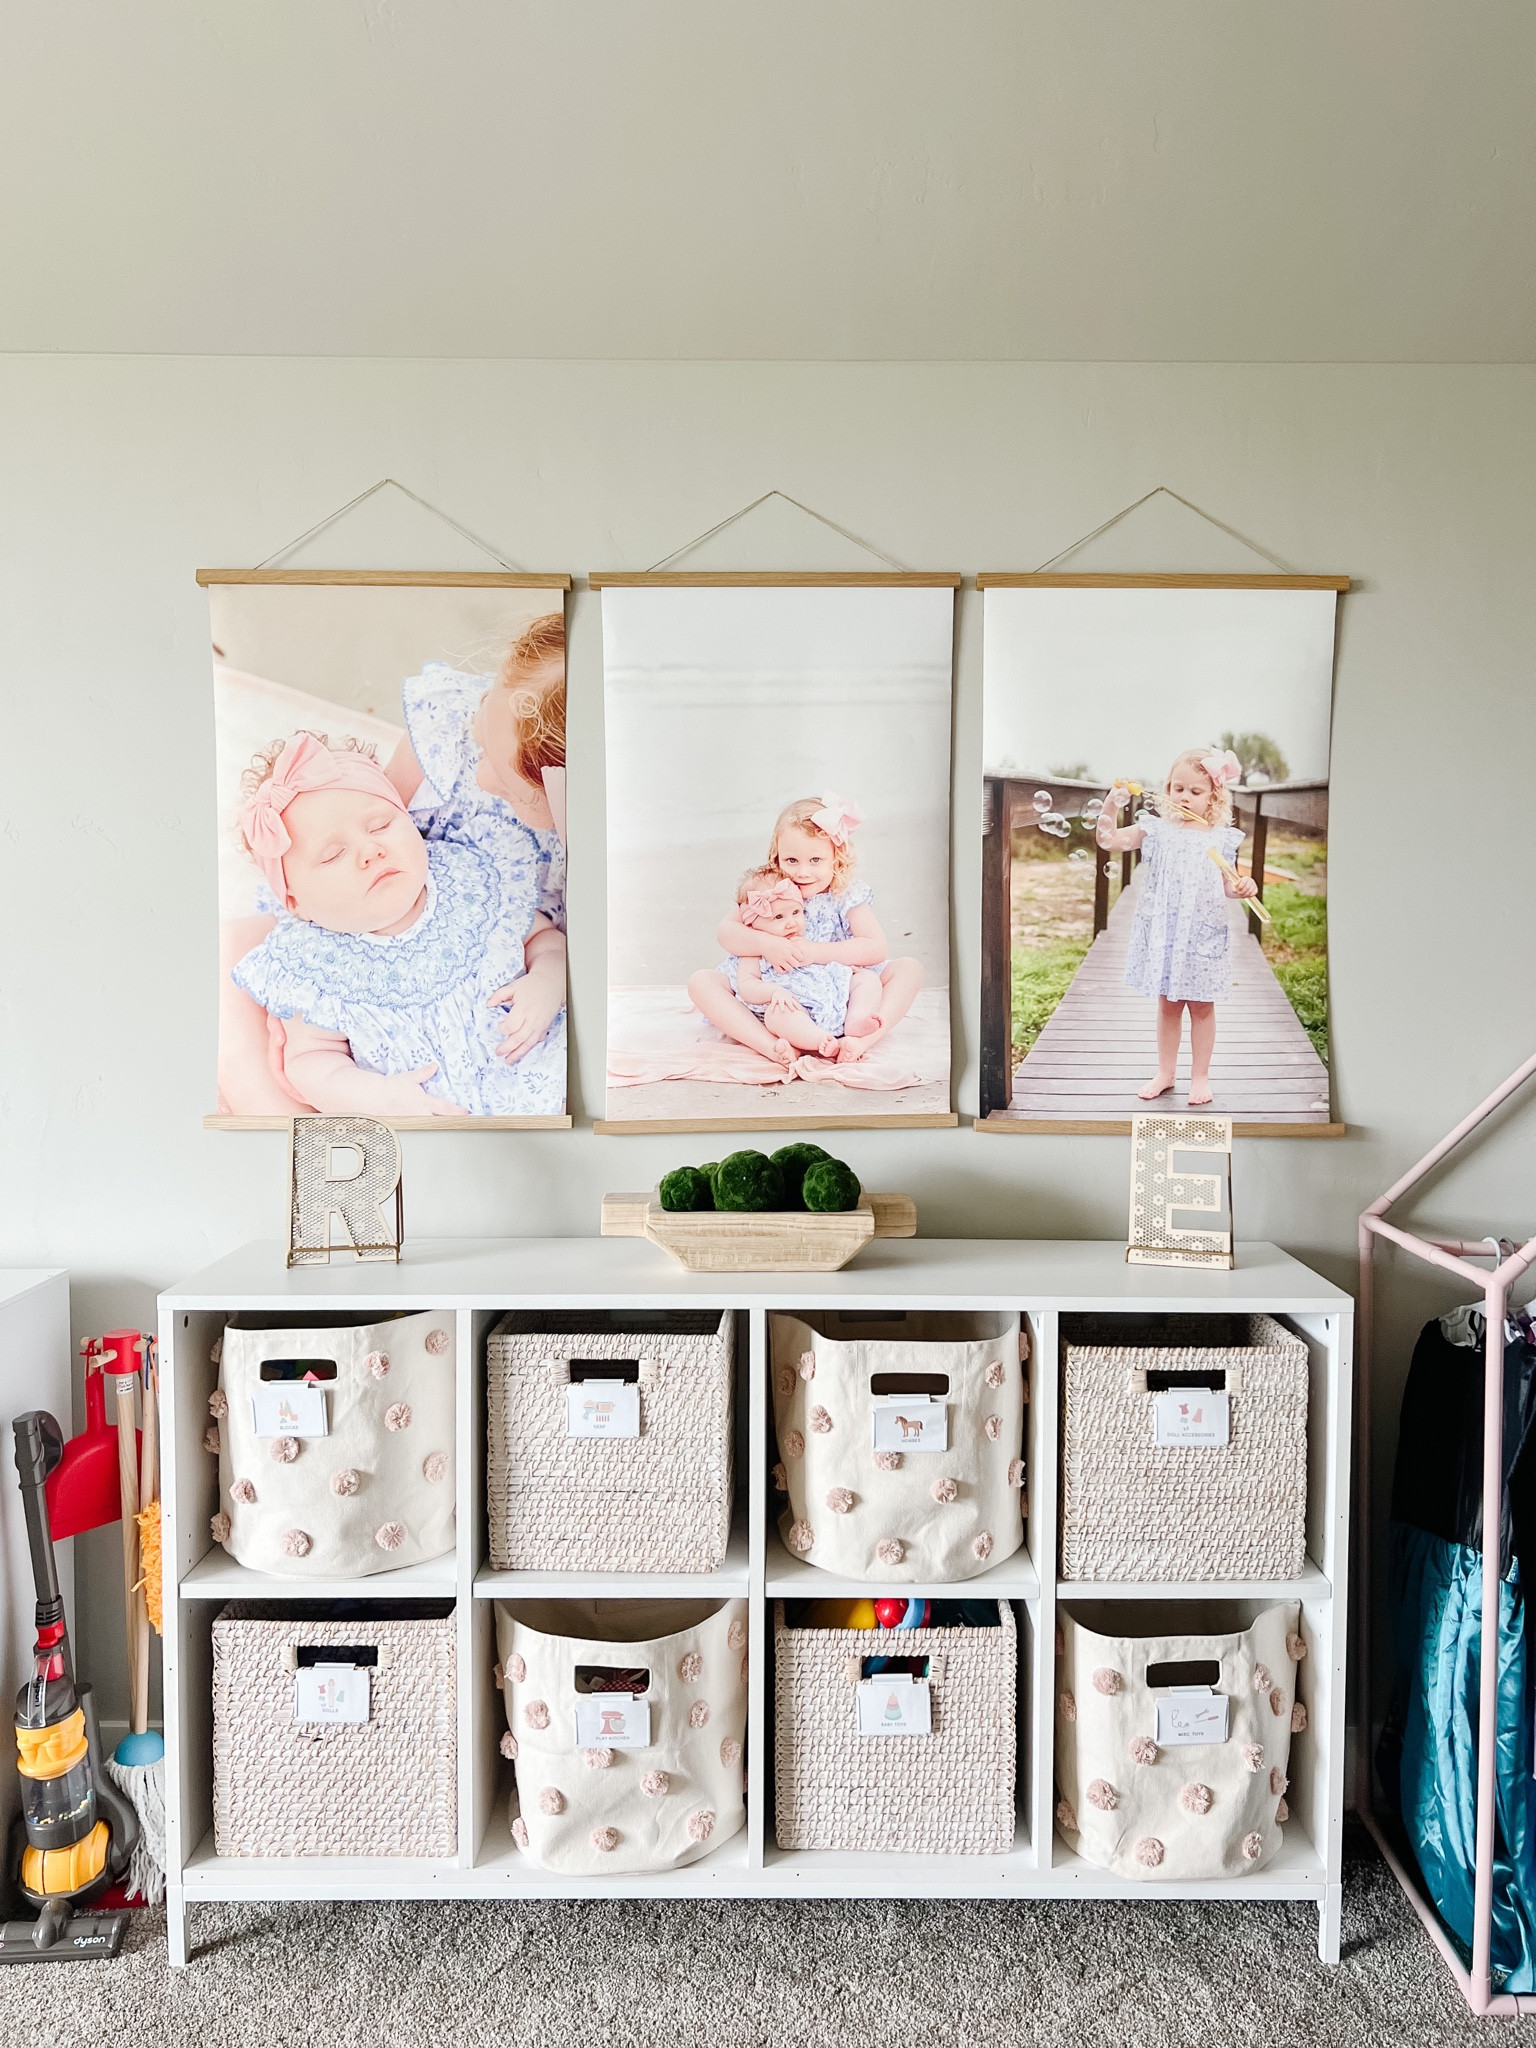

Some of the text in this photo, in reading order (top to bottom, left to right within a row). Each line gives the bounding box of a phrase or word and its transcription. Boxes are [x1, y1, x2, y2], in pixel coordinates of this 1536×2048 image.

[286, 1112, 402, 1264] R
[1128, 1113, 1232, 1270] E
[73, 1936, 106, 1948] dyson
